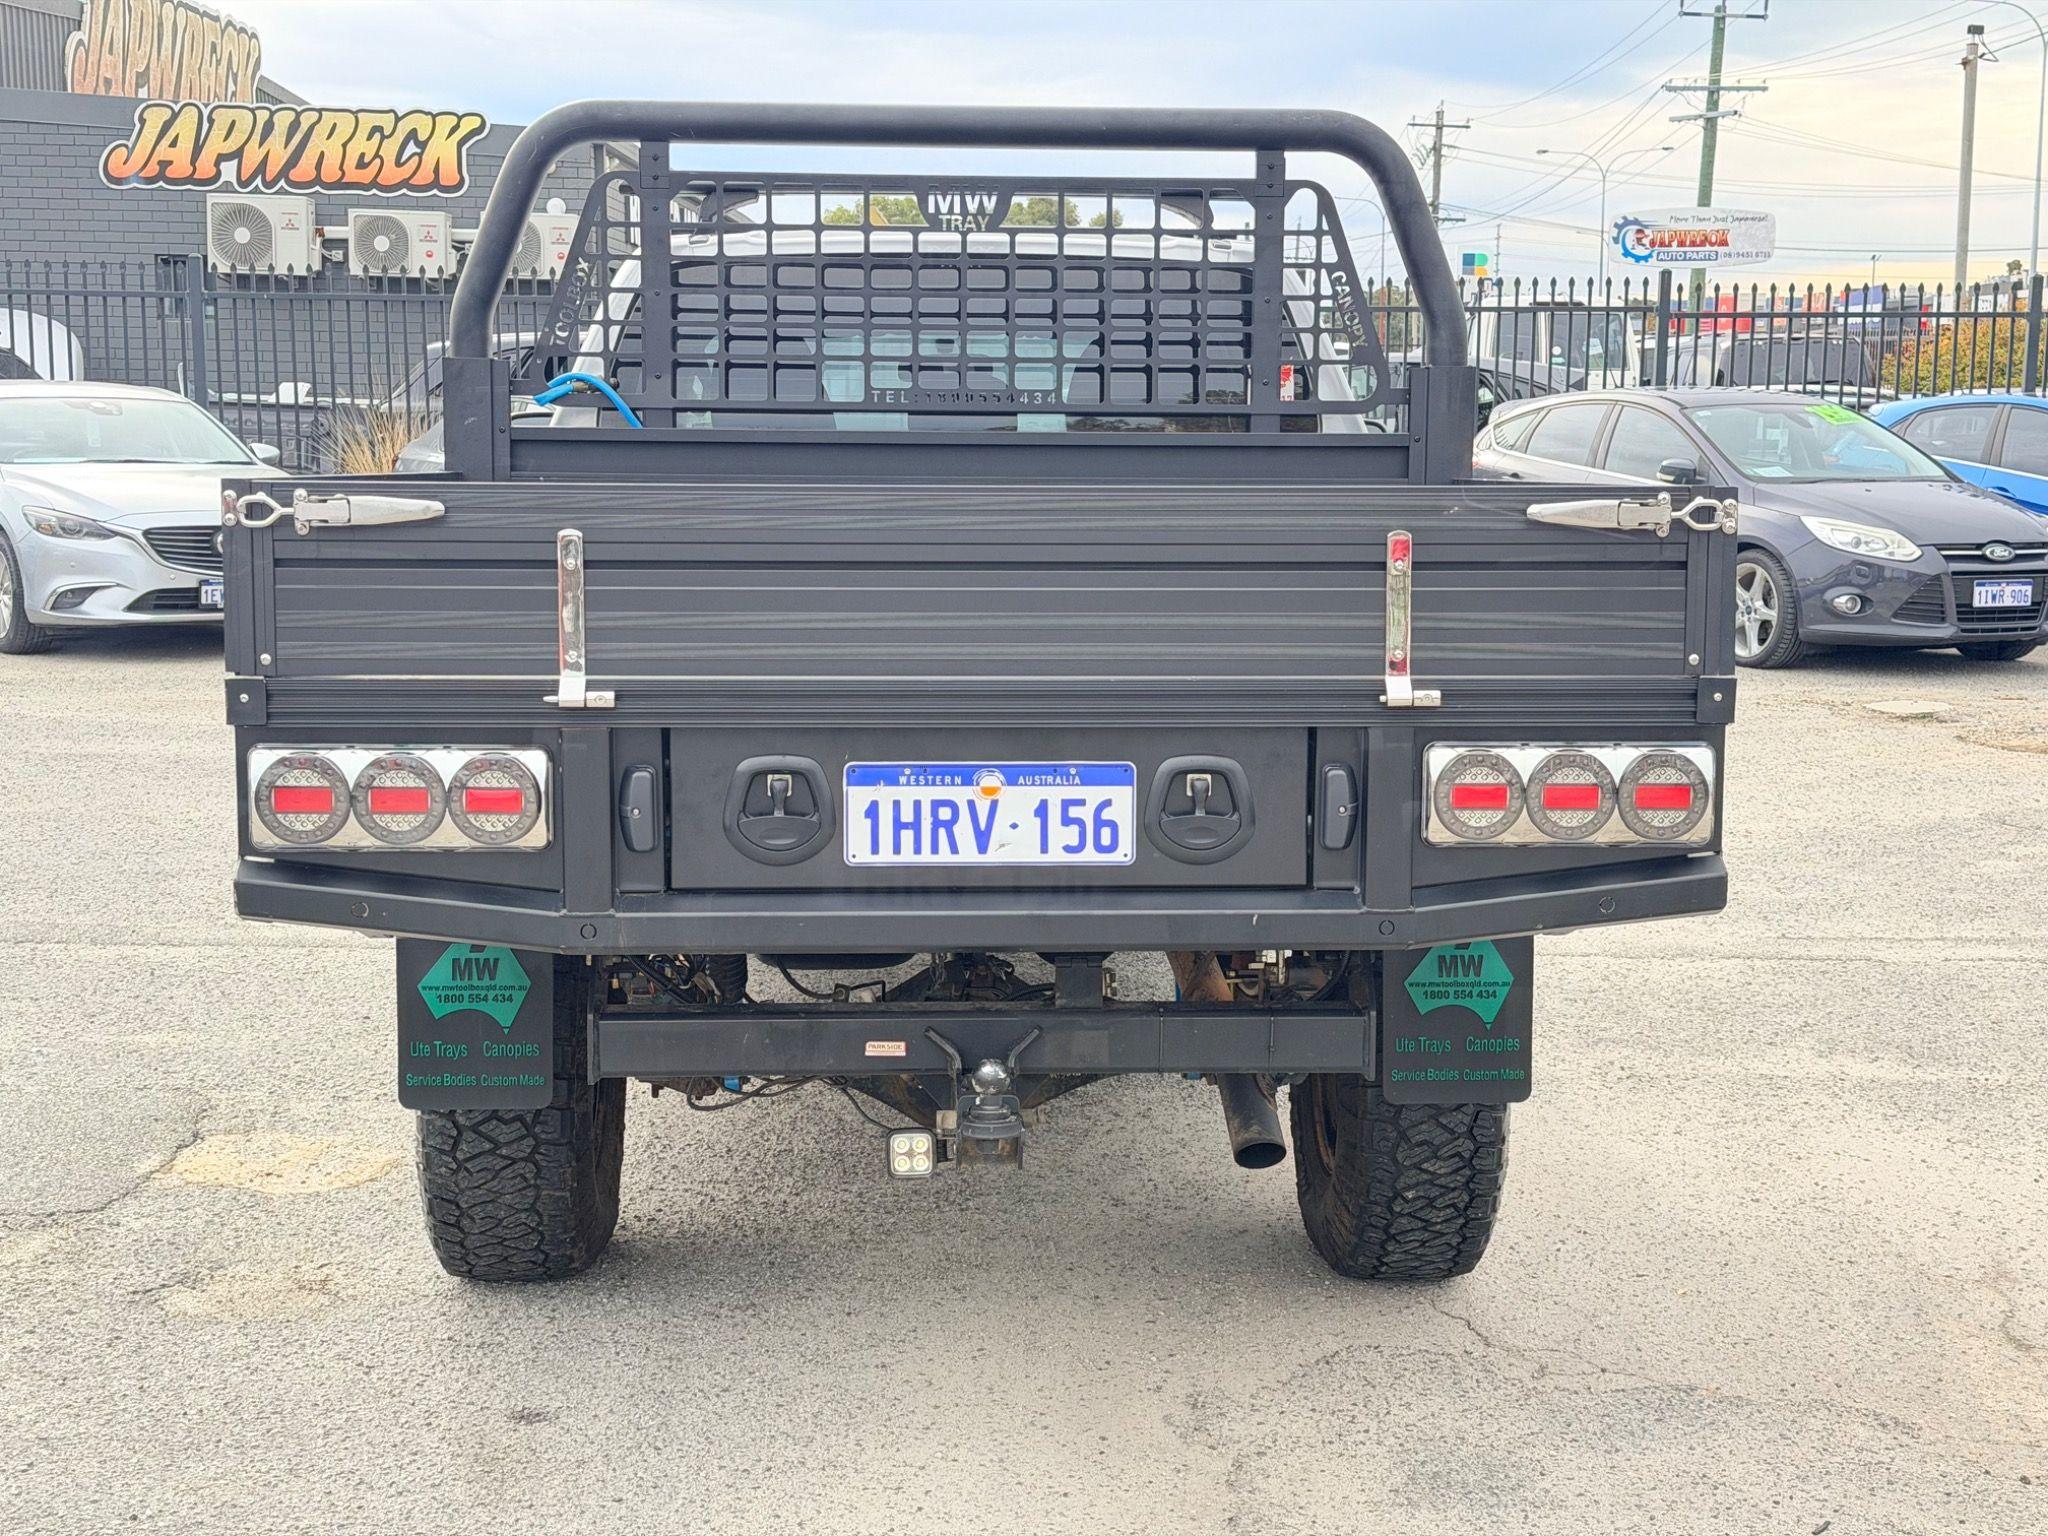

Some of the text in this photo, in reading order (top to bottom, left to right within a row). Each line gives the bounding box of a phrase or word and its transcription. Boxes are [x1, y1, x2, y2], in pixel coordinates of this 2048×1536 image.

[69, 0, 260, 104] JAPWRECK
[105, 102, 484, 189] JAPWRECK
[938, 214, 990, 232] TRAY
[1658, 252, 1685, 261] AUTO
[1686, 252, 1717, 261] PARTS
[549, 256, 590, 346] TOOLBOX
[1331, 271, 1369, 347] CANOPY
[898, 775, 1081, 786] WESTERN AUSTRALIA
[451, 957, 500, 982] MW
[1437, 954, 1484, 978] MW
[436, 993, 514, 1004] 1800 554 434
[1423, 989, 1498, 1000] 1800 554 434
[410, 1040, 540, 1060] Ute Trays Canopies
[867, 1043, 903, 1051] PARKSIDE
[1395, 1035, 1520, 1055] Ute Trays Canopies
[406, 1073, 545, 1087] Service Bodies Custom Made
[1391, 1067, 1525, 1081] Service Bodies Custom Made
